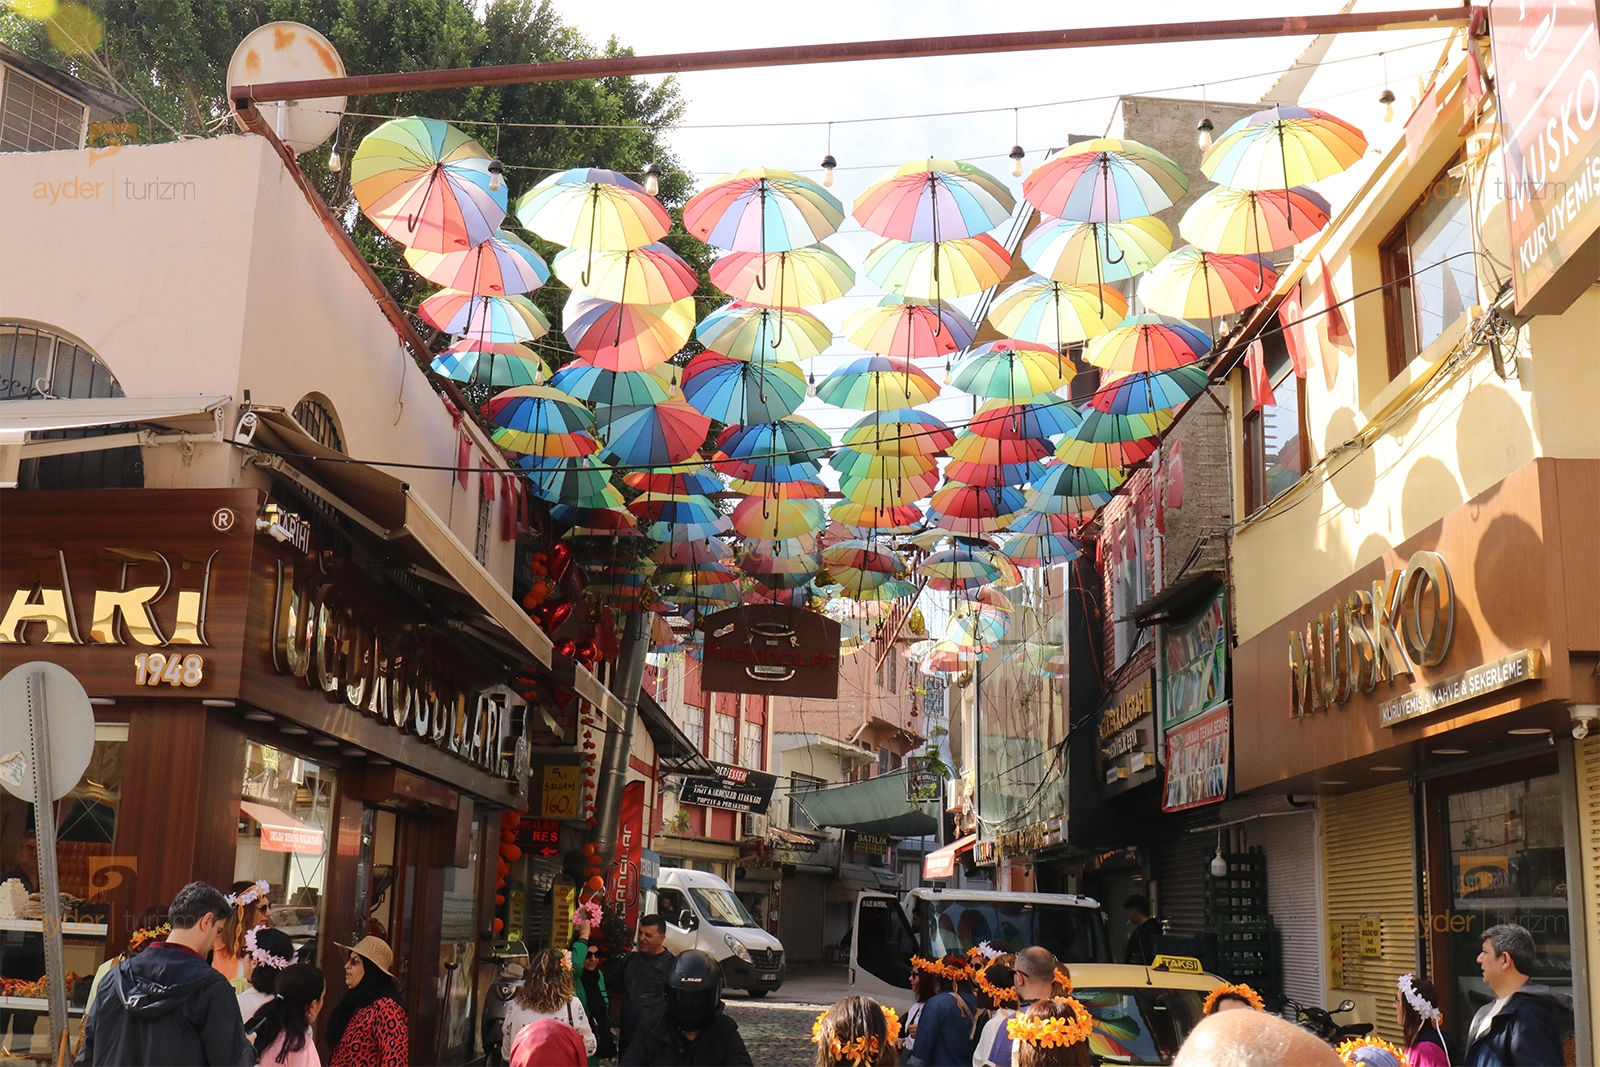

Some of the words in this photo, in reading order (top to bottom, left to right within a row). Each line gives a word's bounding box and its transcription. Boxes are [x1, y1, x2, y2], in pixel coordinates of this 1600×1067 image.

[1510, 69, 1599, 222] MUSKO
[1288, 550, 1453, 719] MUSKO
[134, 652, 204, 688] 1948
[1382, 692, 1423, 723] KURUYEMİŞ
[1431, 682, 1460, 706] KAHVE
[1461, 681, 1468, 696] &
[1469, 659, 1523, 695] ŞEKERLEME
[532, 830, 559, 843] RES
[857, 833, 888, 846] SATILIK
